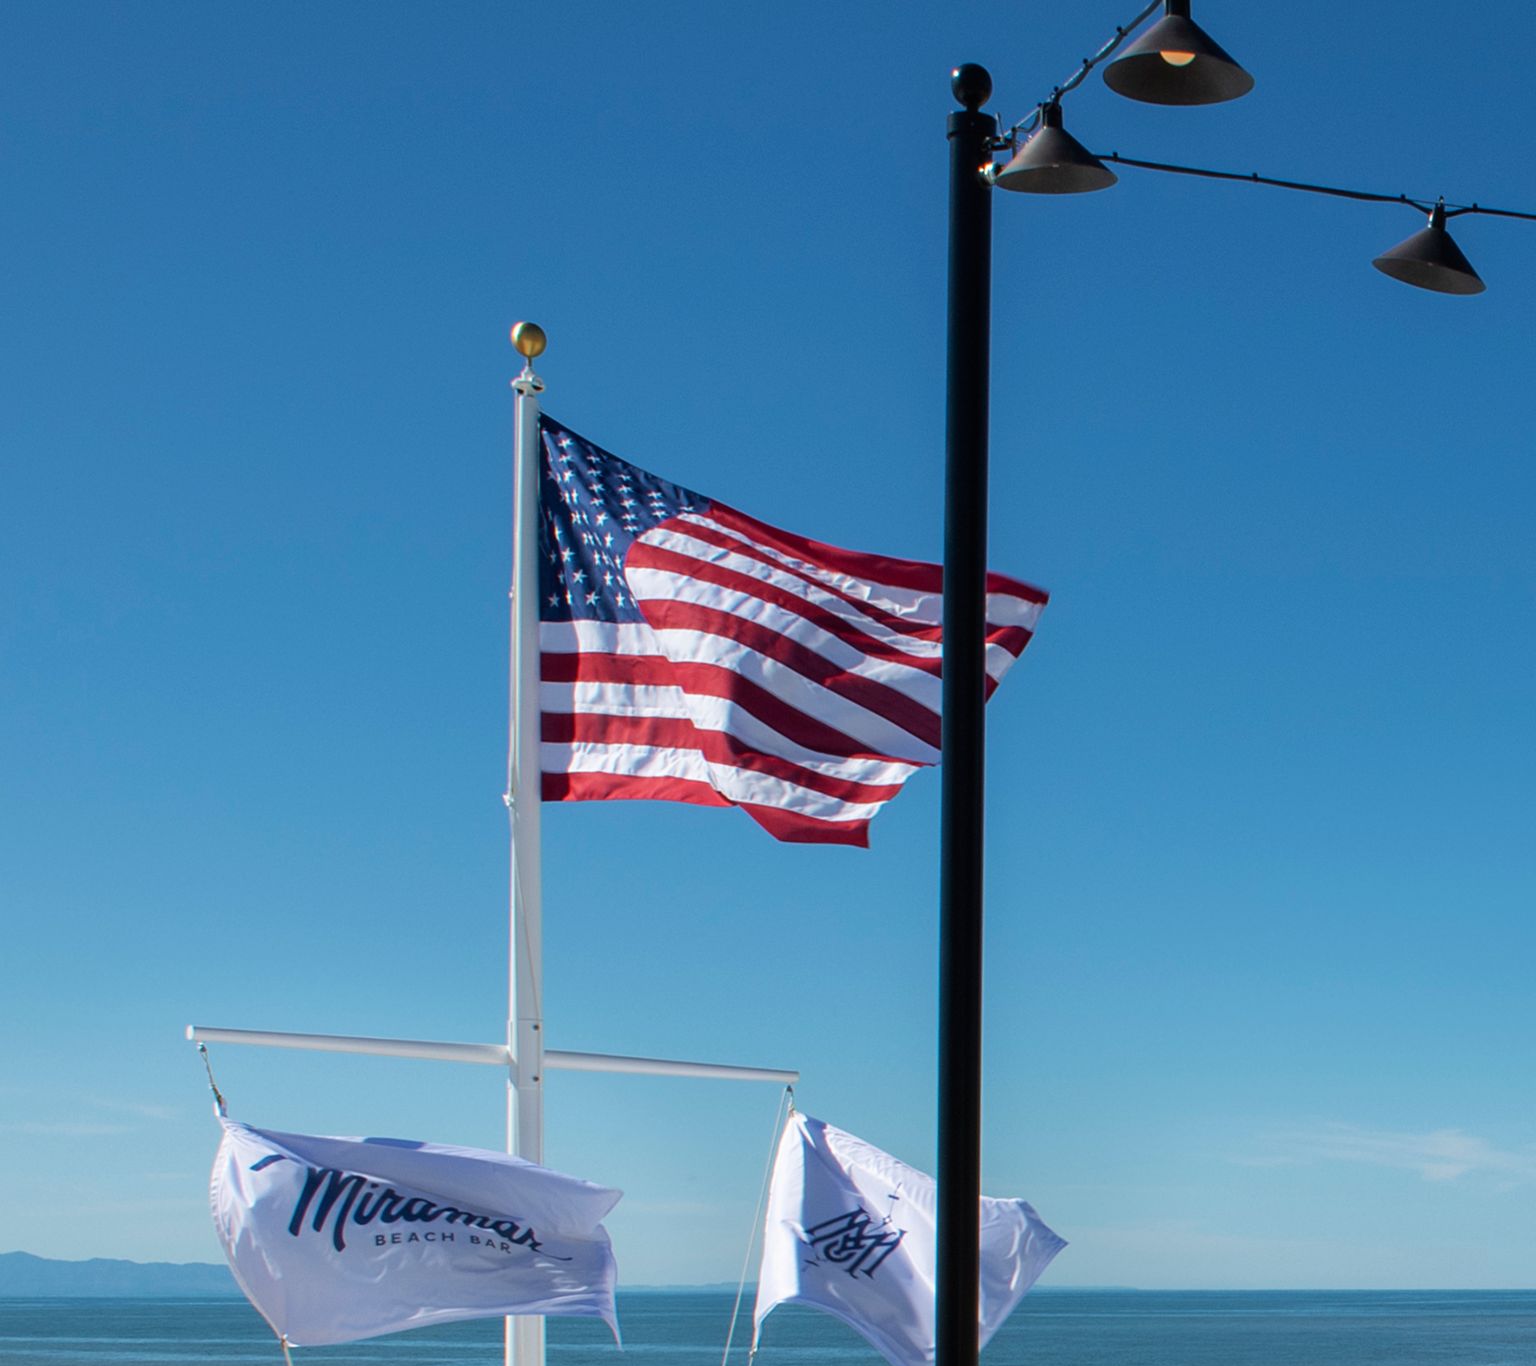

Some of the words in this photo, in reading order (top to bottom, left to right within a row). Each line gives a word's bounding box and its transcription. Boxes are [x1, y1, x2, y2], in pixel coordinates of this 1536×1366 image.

[287, 1166, 573, 1261] Miramar
[374, 1231, 455, 1247] BEACH
[469, 1234, 512, 1254] BAR
